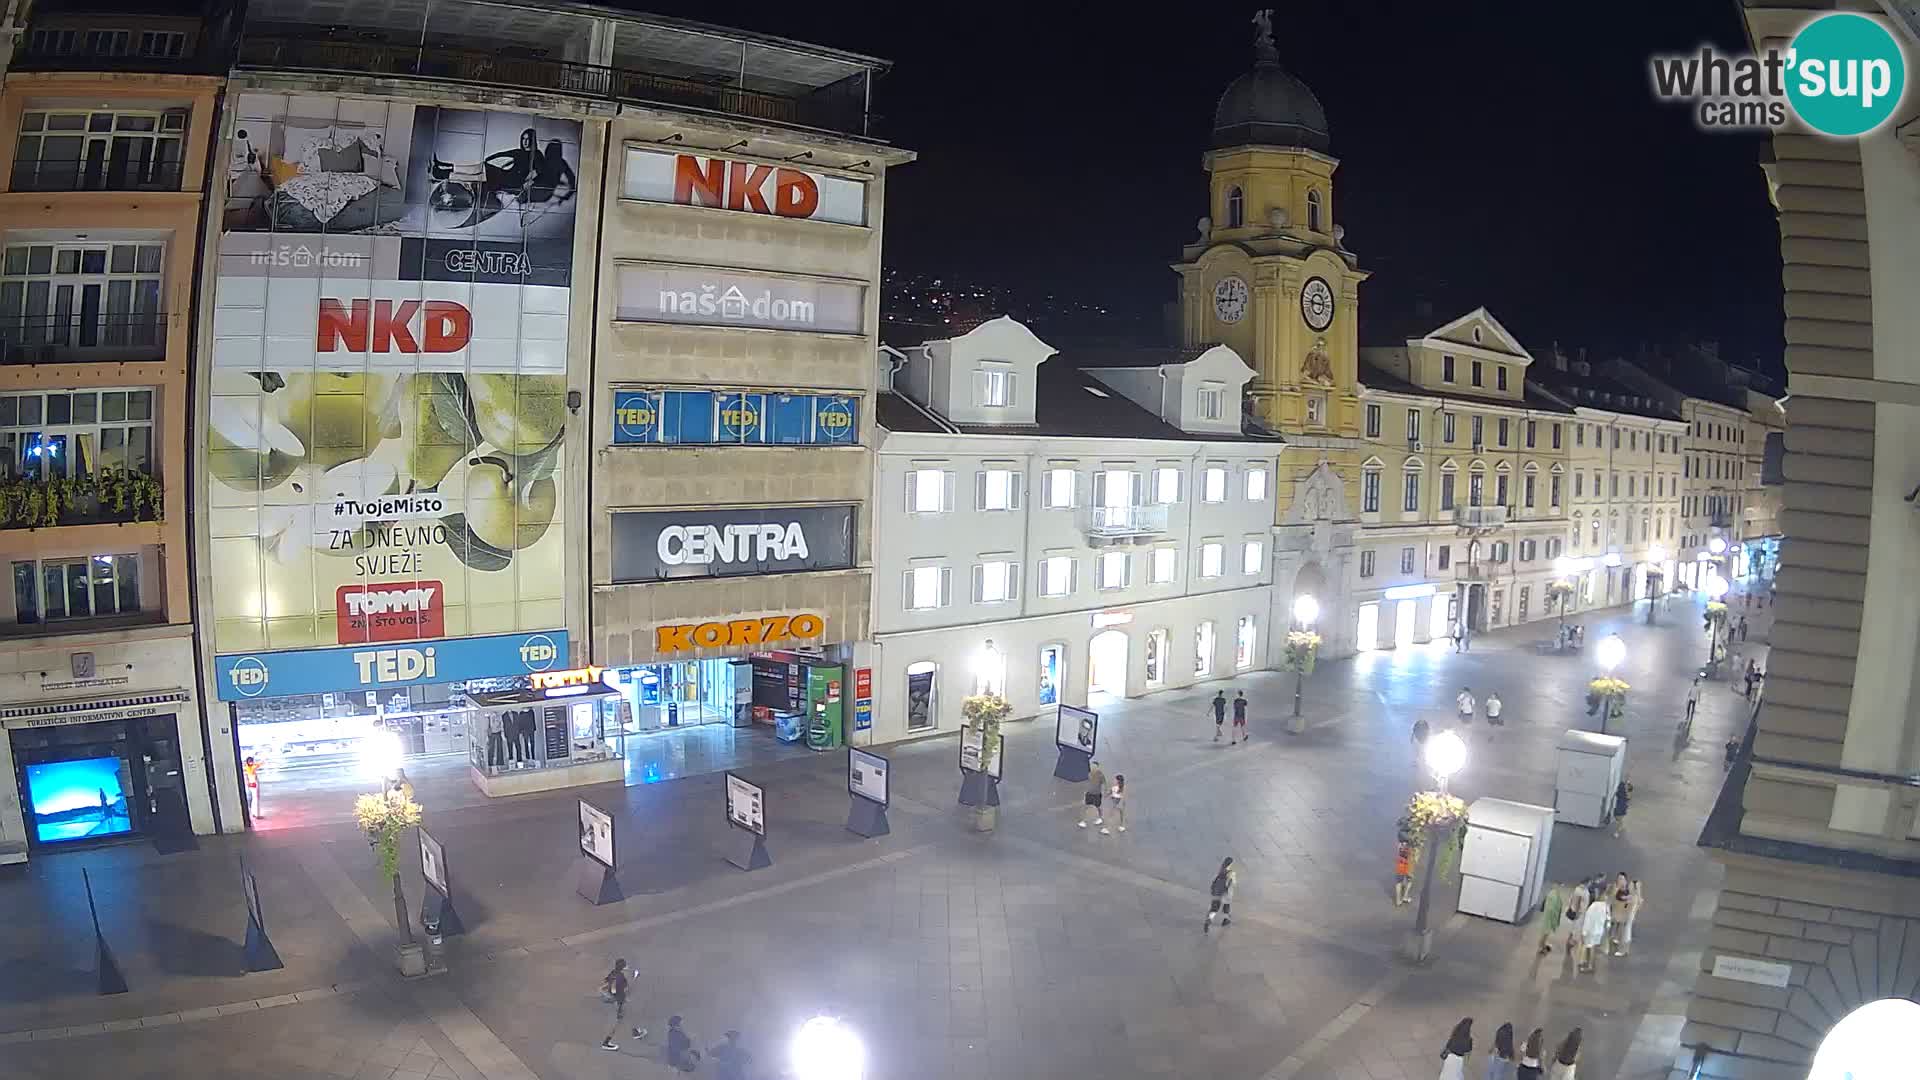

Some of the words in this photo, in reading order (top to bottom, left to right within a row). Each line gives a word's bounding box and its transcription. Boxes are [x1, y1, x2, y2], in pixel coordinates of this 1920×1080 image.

[674, 154, 819, 218] NKD
[250, 244, 290, 266] naš
[316, 248, 361, 268] dom
[445, 250, 532, 276] CENTRA
[659, 285, 716, 316] naš
[753, 290, 816, 323] dom
[317, 298, 474, 355] NKD
[616, 408, 656, 426] TEDi
[722, 410, 758, 427] TEDi
[818, 412, 852, 428] TEDi
[335, 498, 443, 517] #TvojeMisto
[329, 529, 354, 550] ZA
[364, 525, 447, 549] DNEVNO
[657, 522, 809, 566] CENTRA
[355, 549, 422, 576] SVJEŽE
[344, 588, 435, 616] TOMMY
[376, 614, 396, 627] ŠTO
[656, 614, 824, 653] KORZO
[519, 644, 557, 662] TEDi
[229, 667, 269, 686] TEDi
[353, 648, 436, 684] TEDi
[530, 664, 602, 690] TOMMY
[126, 708, 157, 718] CENTAR
